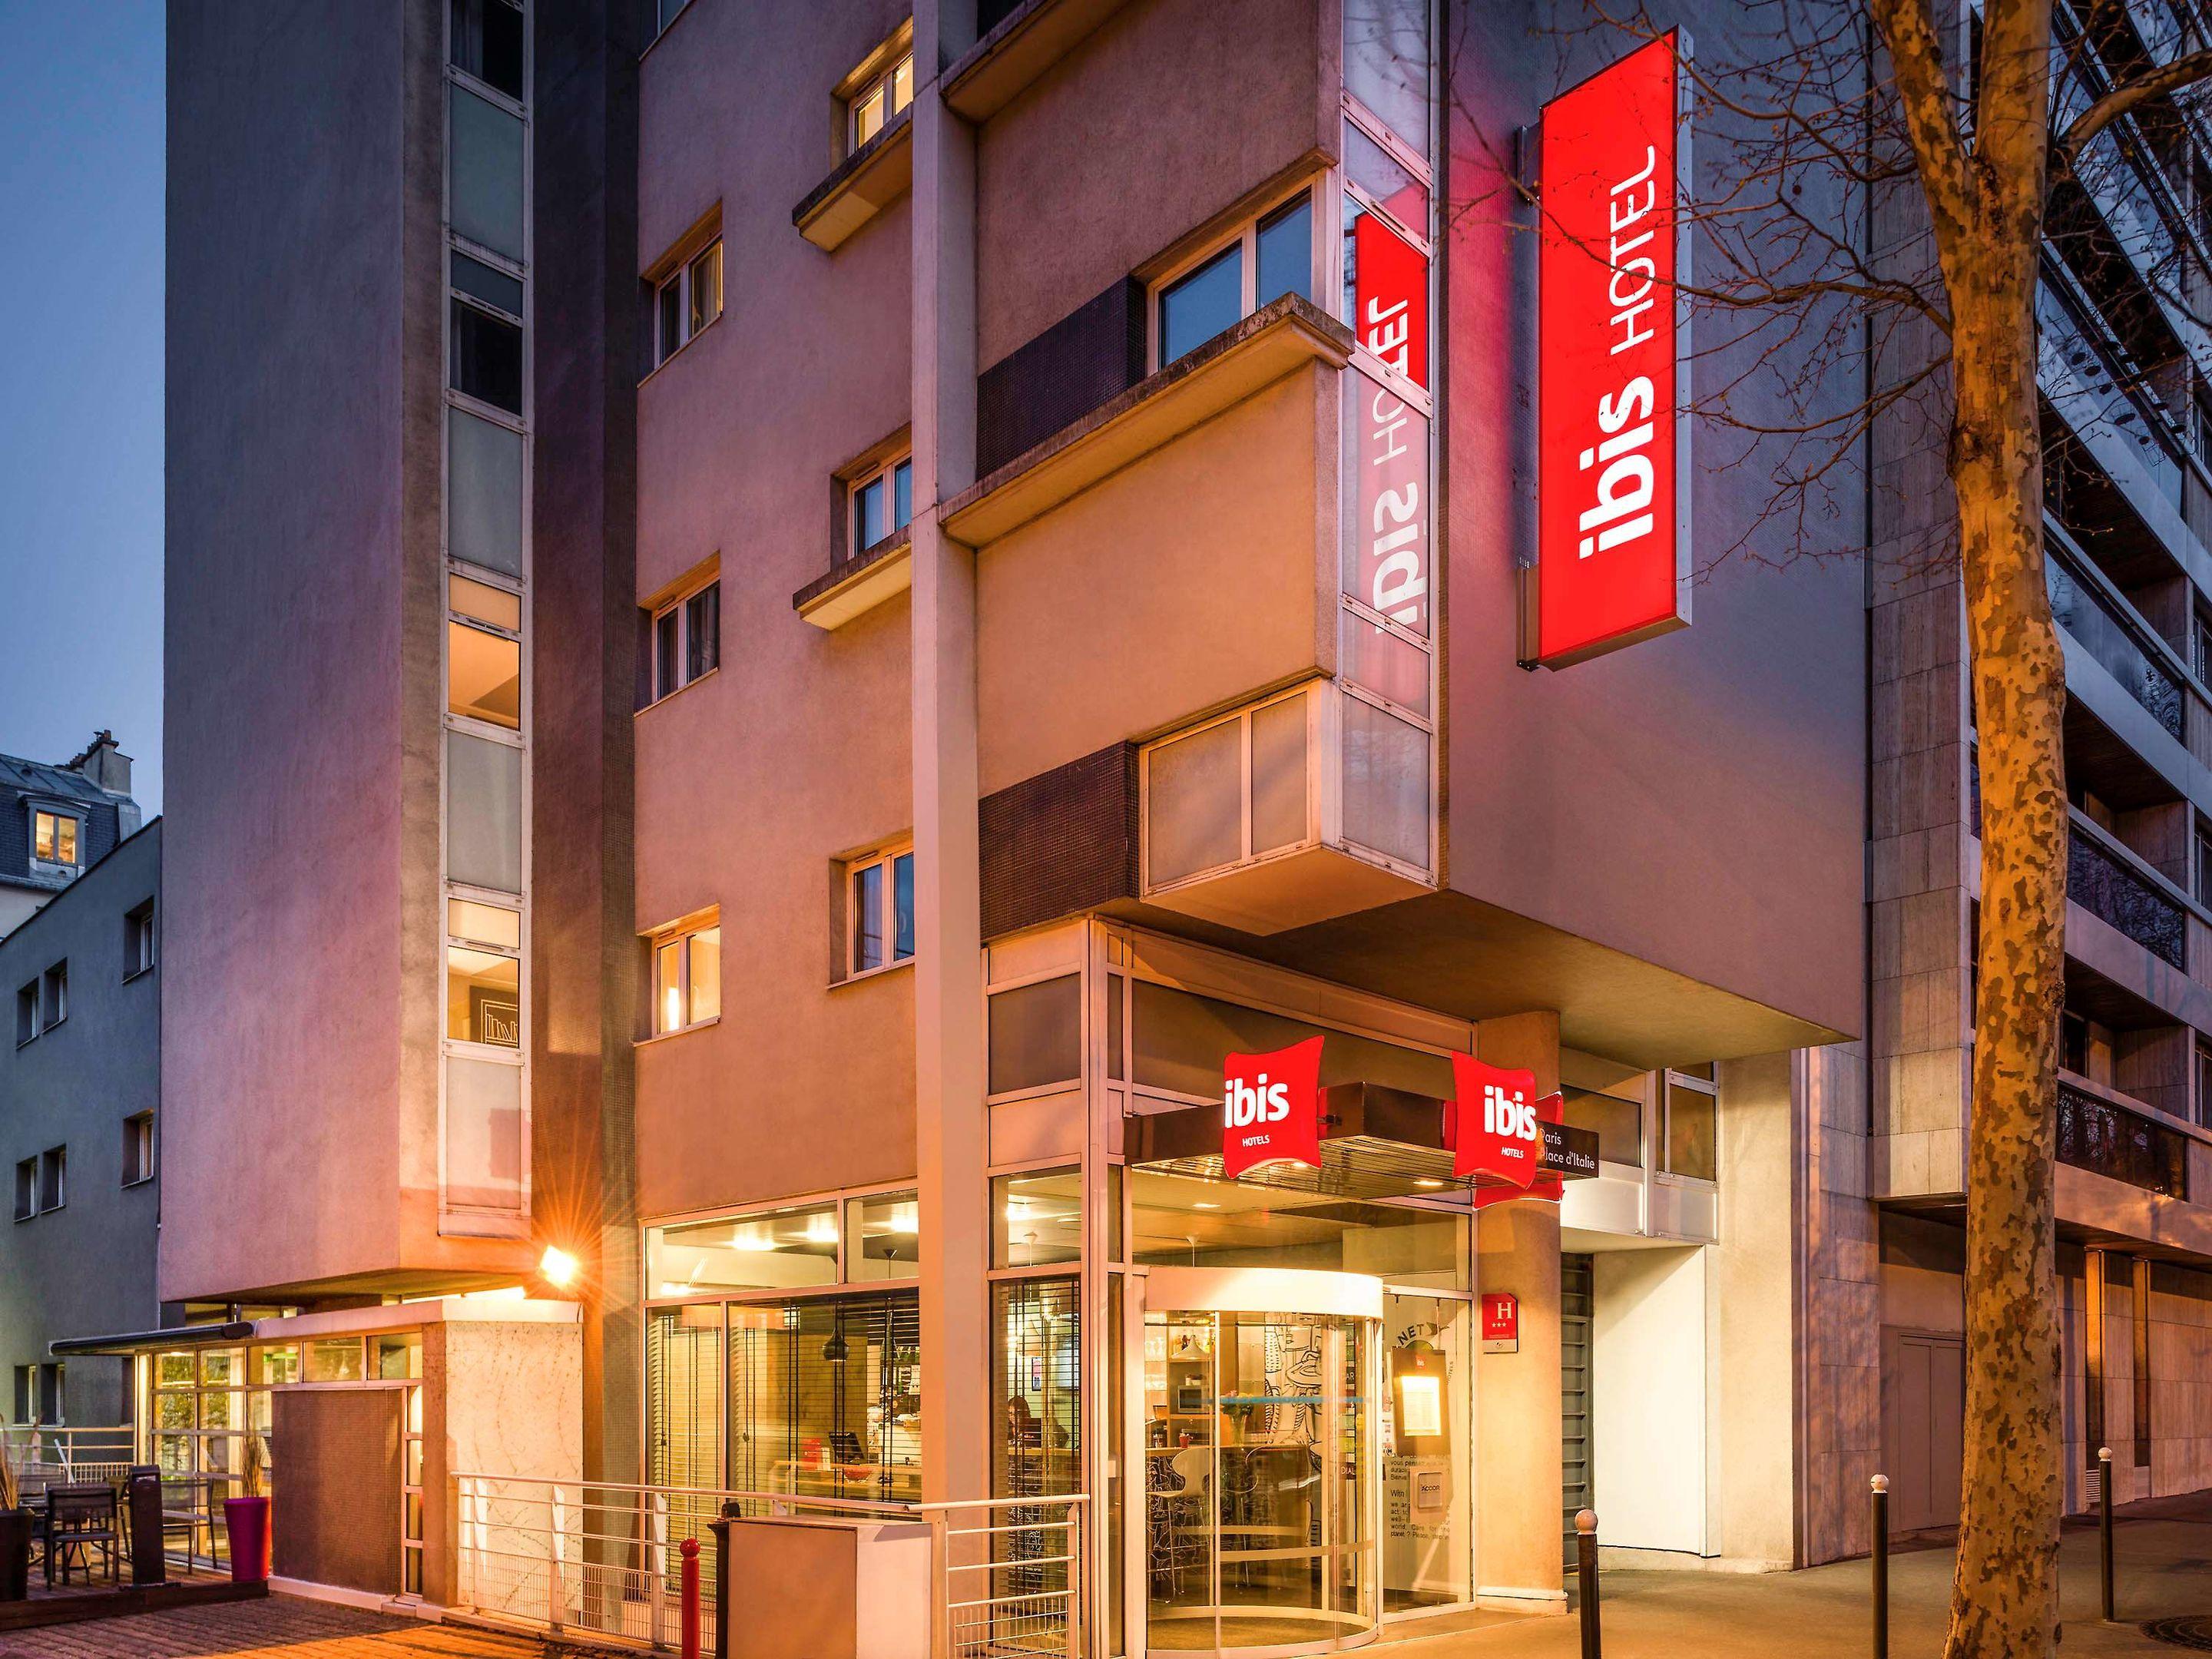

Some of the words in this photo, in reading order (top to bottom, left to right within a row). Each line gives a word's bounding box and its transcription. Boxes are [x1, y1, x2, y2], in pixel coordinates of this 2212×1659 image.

[1610, 145, 1655, 356] HOTEL
[1579, 376, 1654, 559] ibis
[1225, 1073, 1290, 1129] ibis
[1484, 1084, 1537, 1141] ibis
[1242, 1134, 1270, 1147] HOTELS
[1501, 1147, 1525, 1158] HOTELS
[1542, 1146, 1557, 1164] lace
[1565, 1151, 1595, 1169] d'Italie
[1496, 1302, 1512, 1320] H
